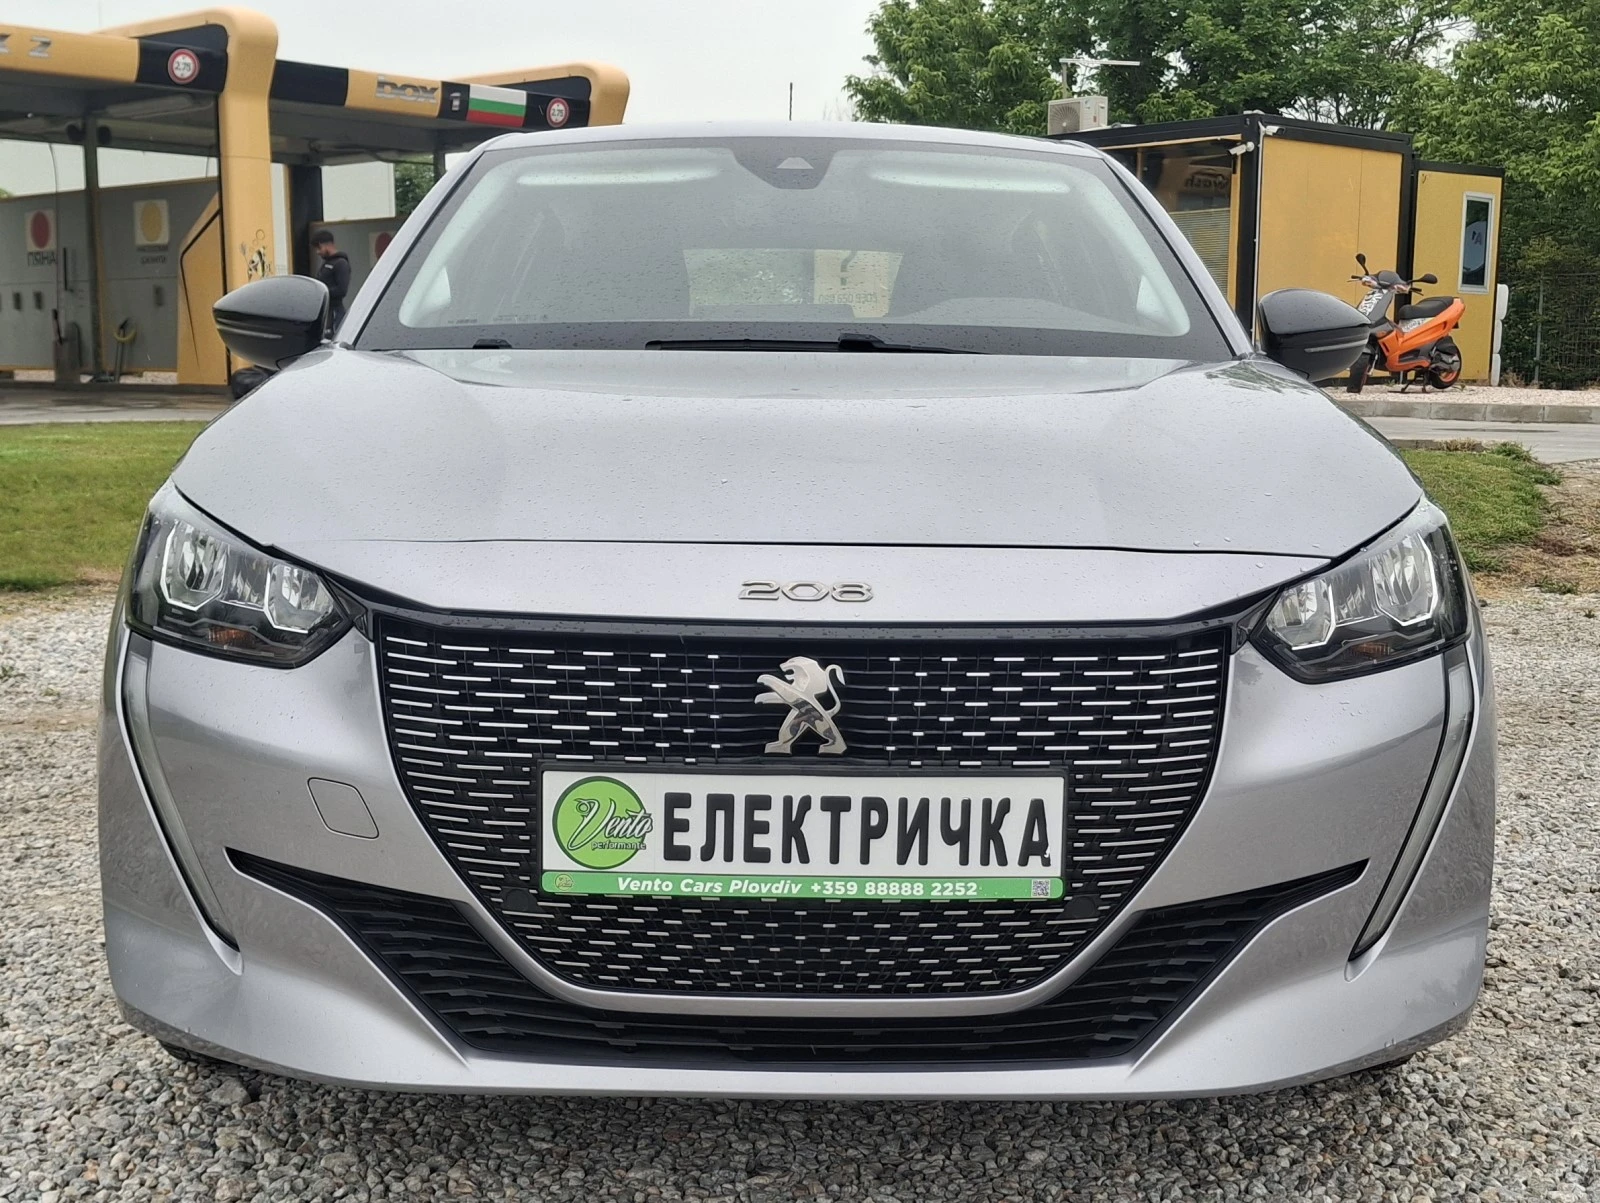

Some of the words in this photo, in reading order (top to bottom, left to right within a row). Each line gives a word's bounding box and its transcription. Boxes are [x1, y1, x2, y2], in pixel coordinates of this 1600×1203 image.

[738, 580, 874, 603] 208
[566, 797, 654, 852] Vento
[663, 791, 1052, 868] ЕЛЕКТРИЧКА
[591, 840, 648, 852] performante
[617, 876, 674, 893] Vento
[680, 878, 723, 894] Cars
[729, 879, 802, 895] Plovdiv
[810, 881, 858, 896] +359
[864, 881, 925, 896] 88888
[930, 882, 978, 897] 2252
